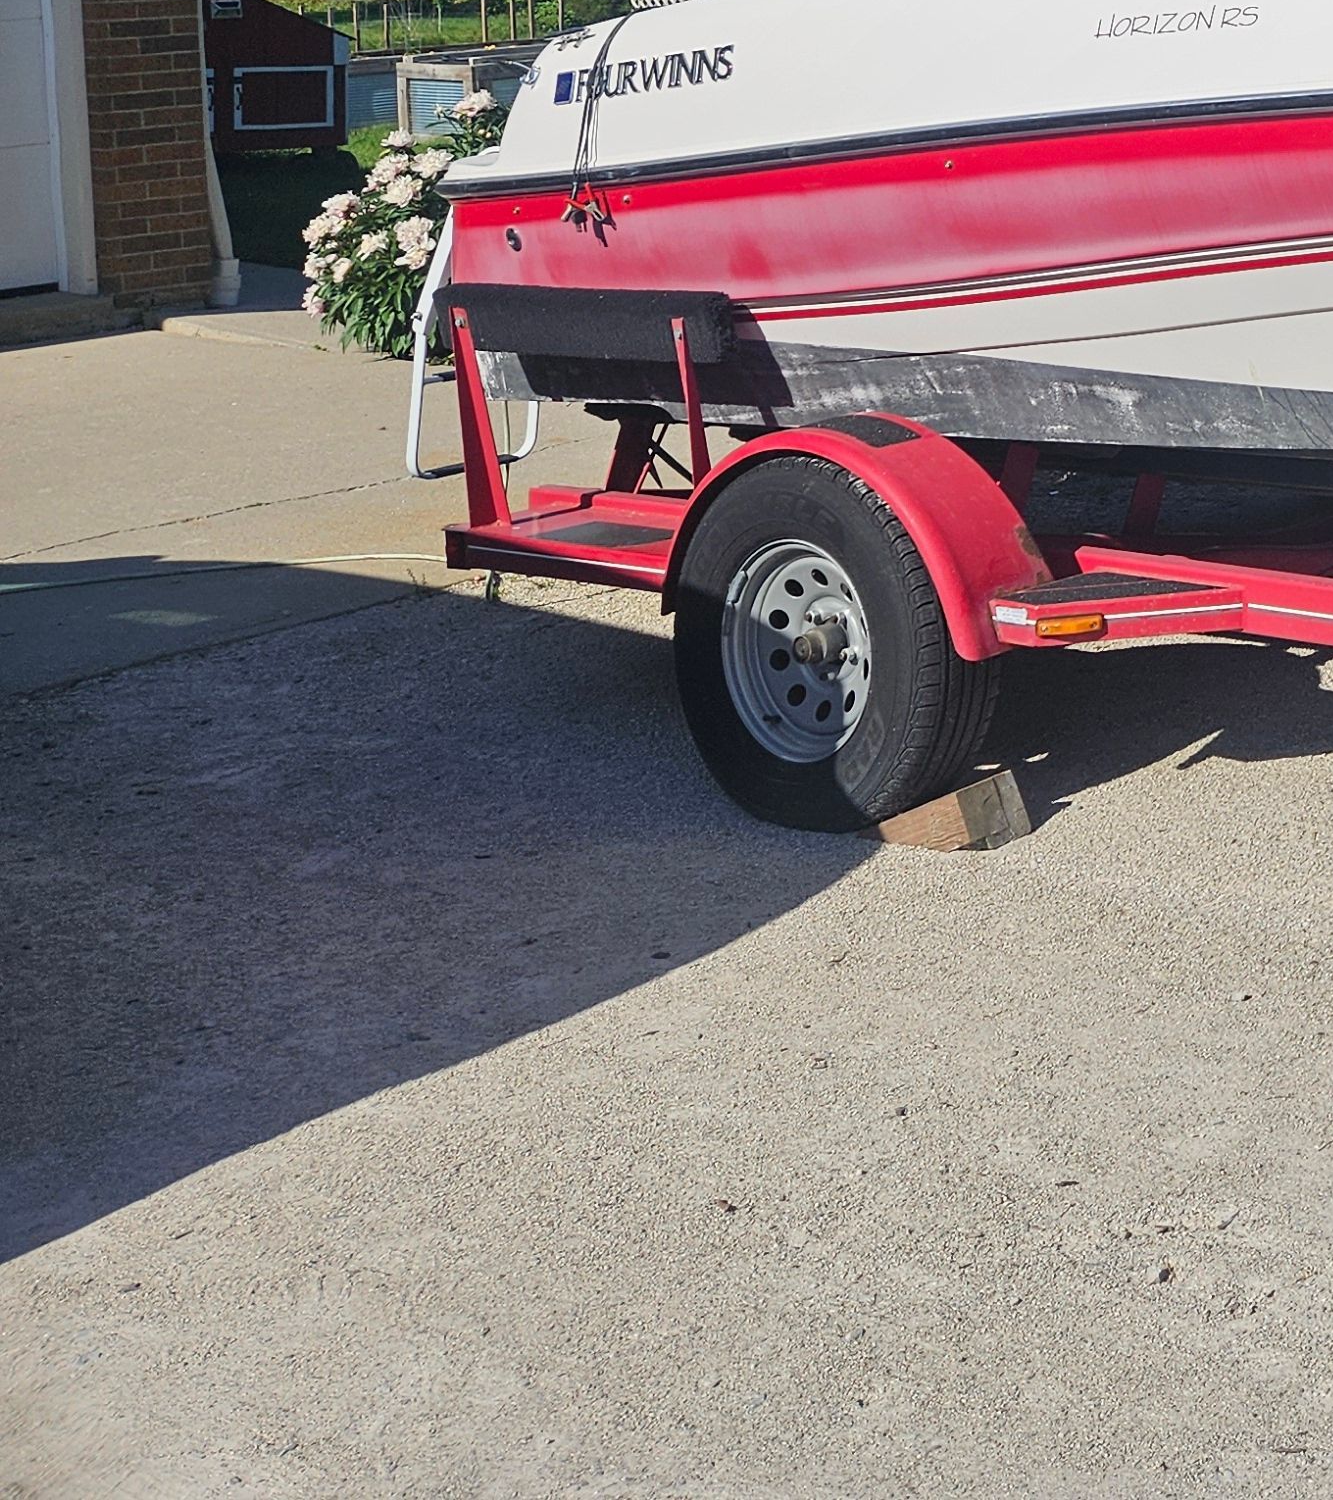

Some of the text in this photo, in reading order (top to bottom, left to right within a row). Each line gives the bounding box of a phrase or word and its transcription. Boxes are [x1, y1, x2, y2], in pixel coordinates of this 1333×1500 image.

[1094, 5, 1259, 38] HORIZON RS
[640, 44, 735, 92] WINNS
